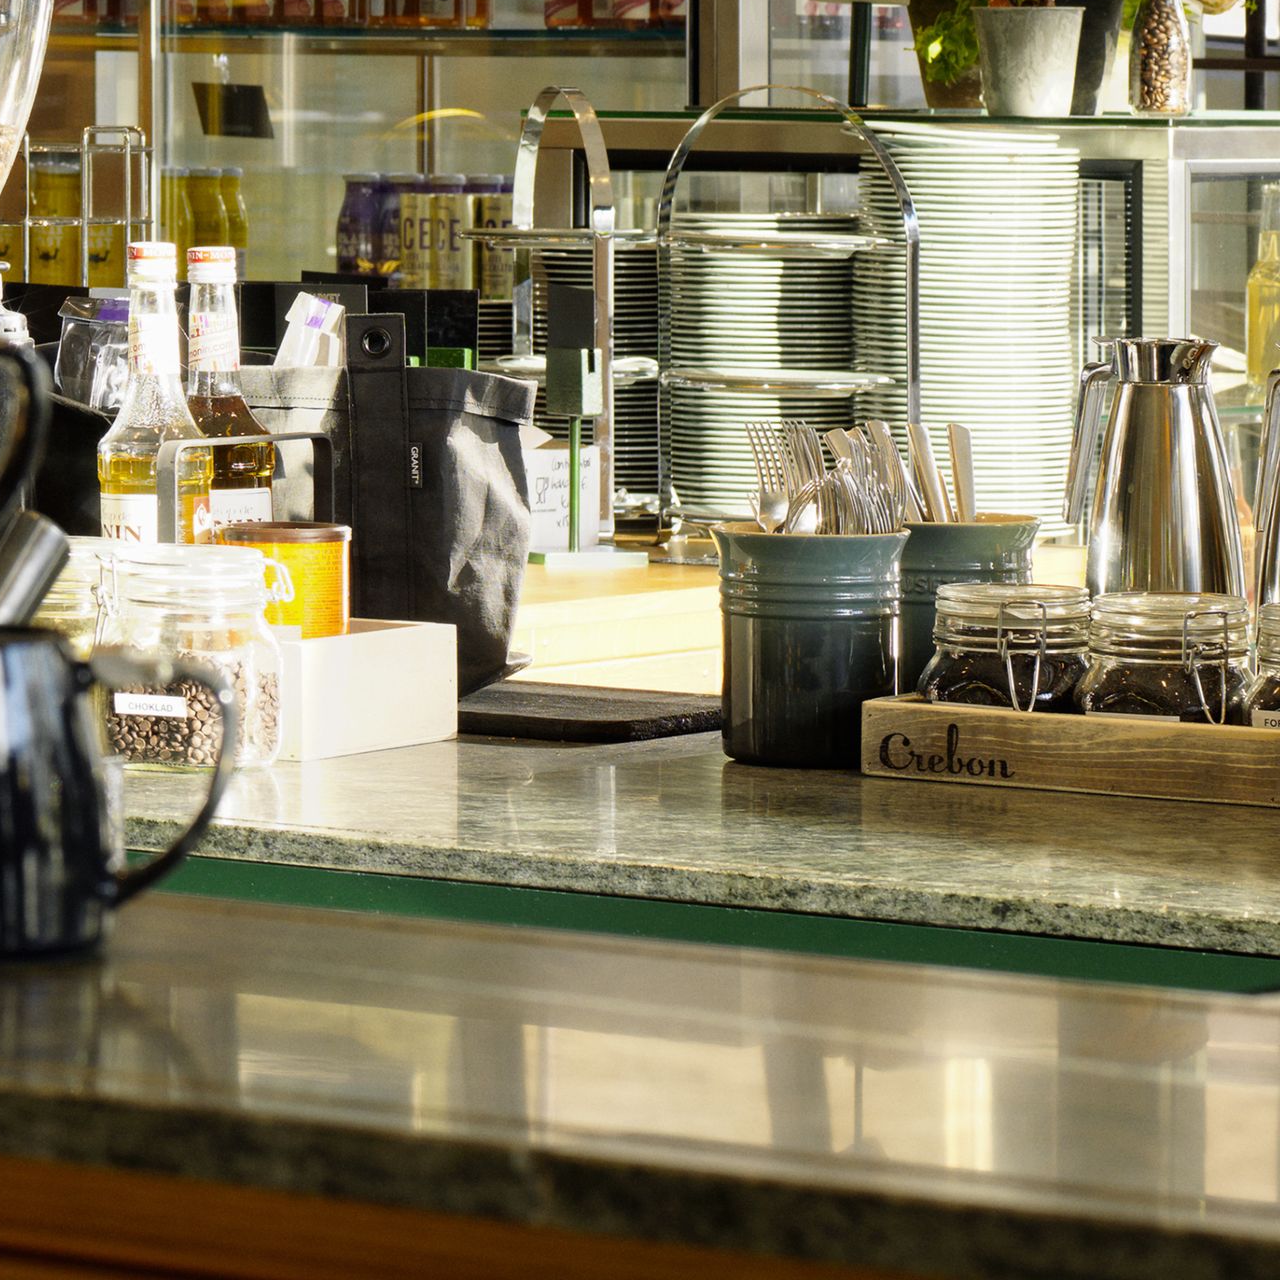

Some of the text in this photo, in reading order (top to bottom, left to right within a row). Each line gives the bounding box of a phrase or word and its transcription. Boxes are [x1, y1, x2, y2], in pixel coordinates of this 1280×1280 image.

[411, 446, 420, 481] GRANIT
[128, 702, 174, 713] CHOKLAD
[878, 722, 1016, 779] Crebon
